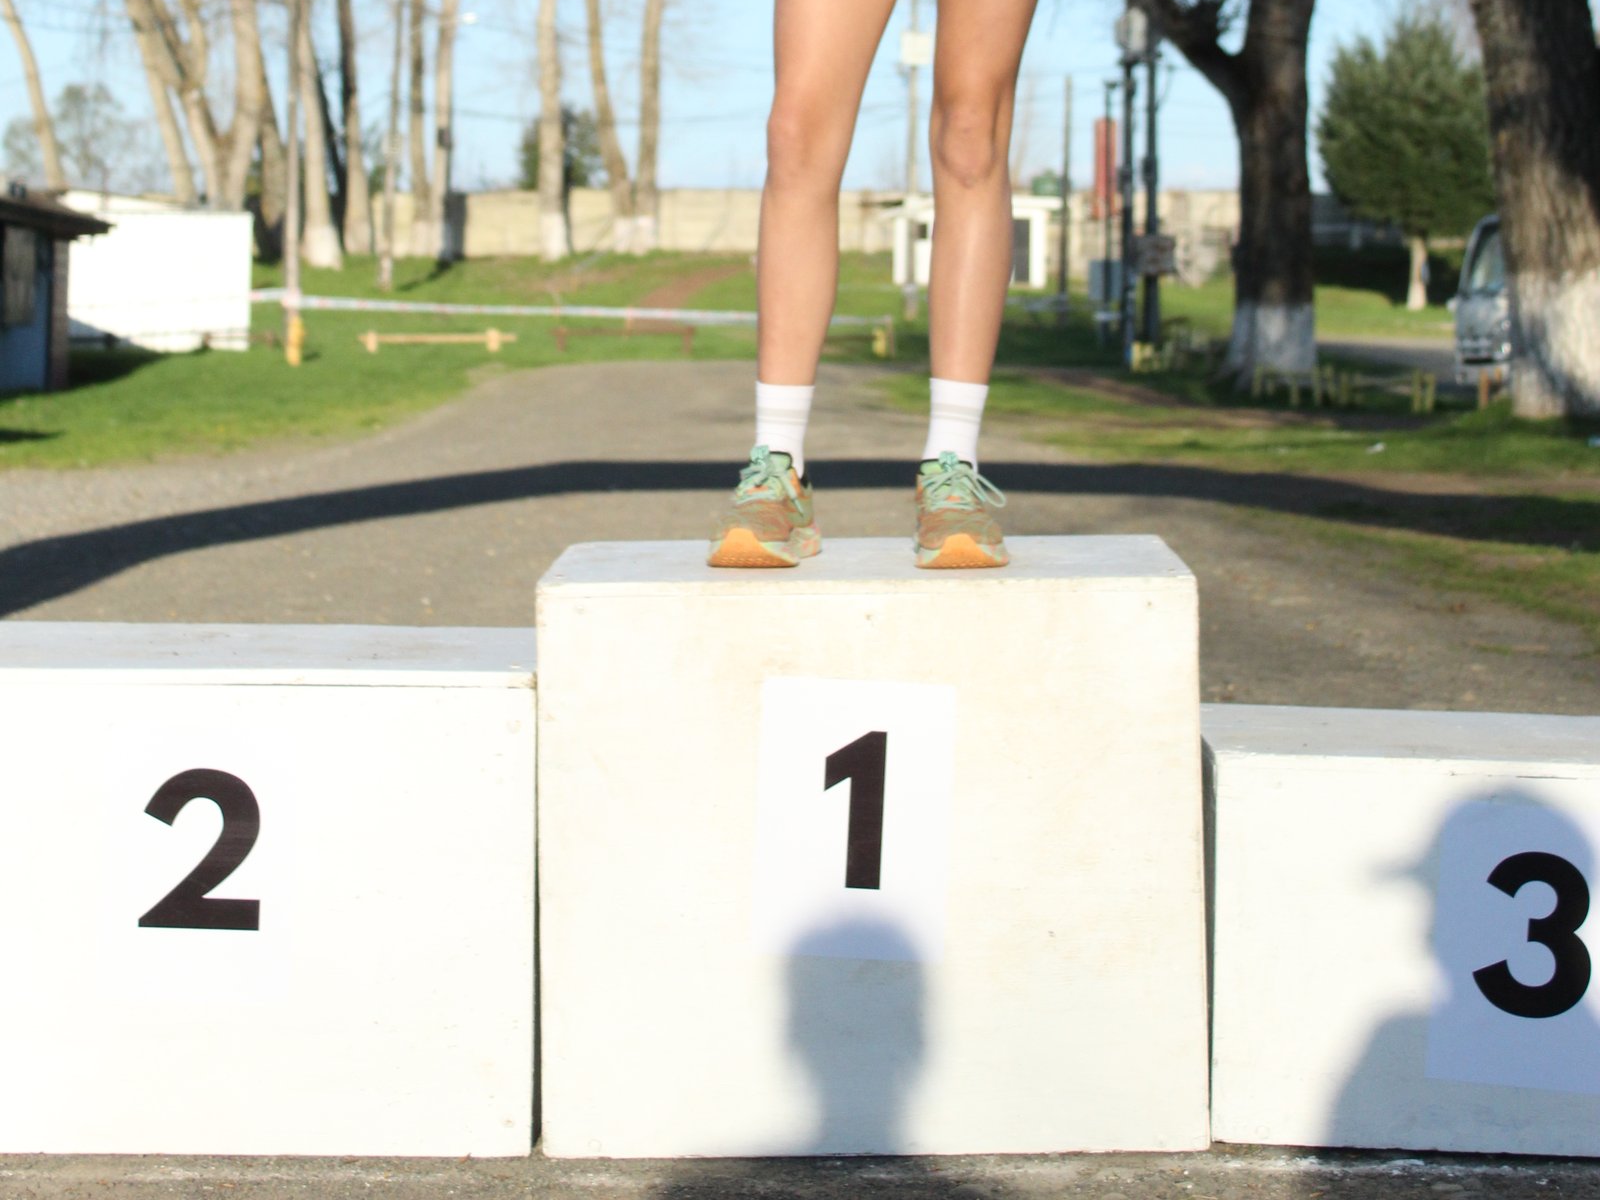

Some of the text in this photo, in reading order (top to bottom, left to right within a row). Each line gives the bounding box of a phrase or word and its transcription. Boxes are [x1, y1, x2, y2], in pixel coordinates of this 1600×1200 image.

[138, 768, 260, 931] 2
[824, 731, 887, 890] 1
[1472, 851, 1591, 1019] 3
